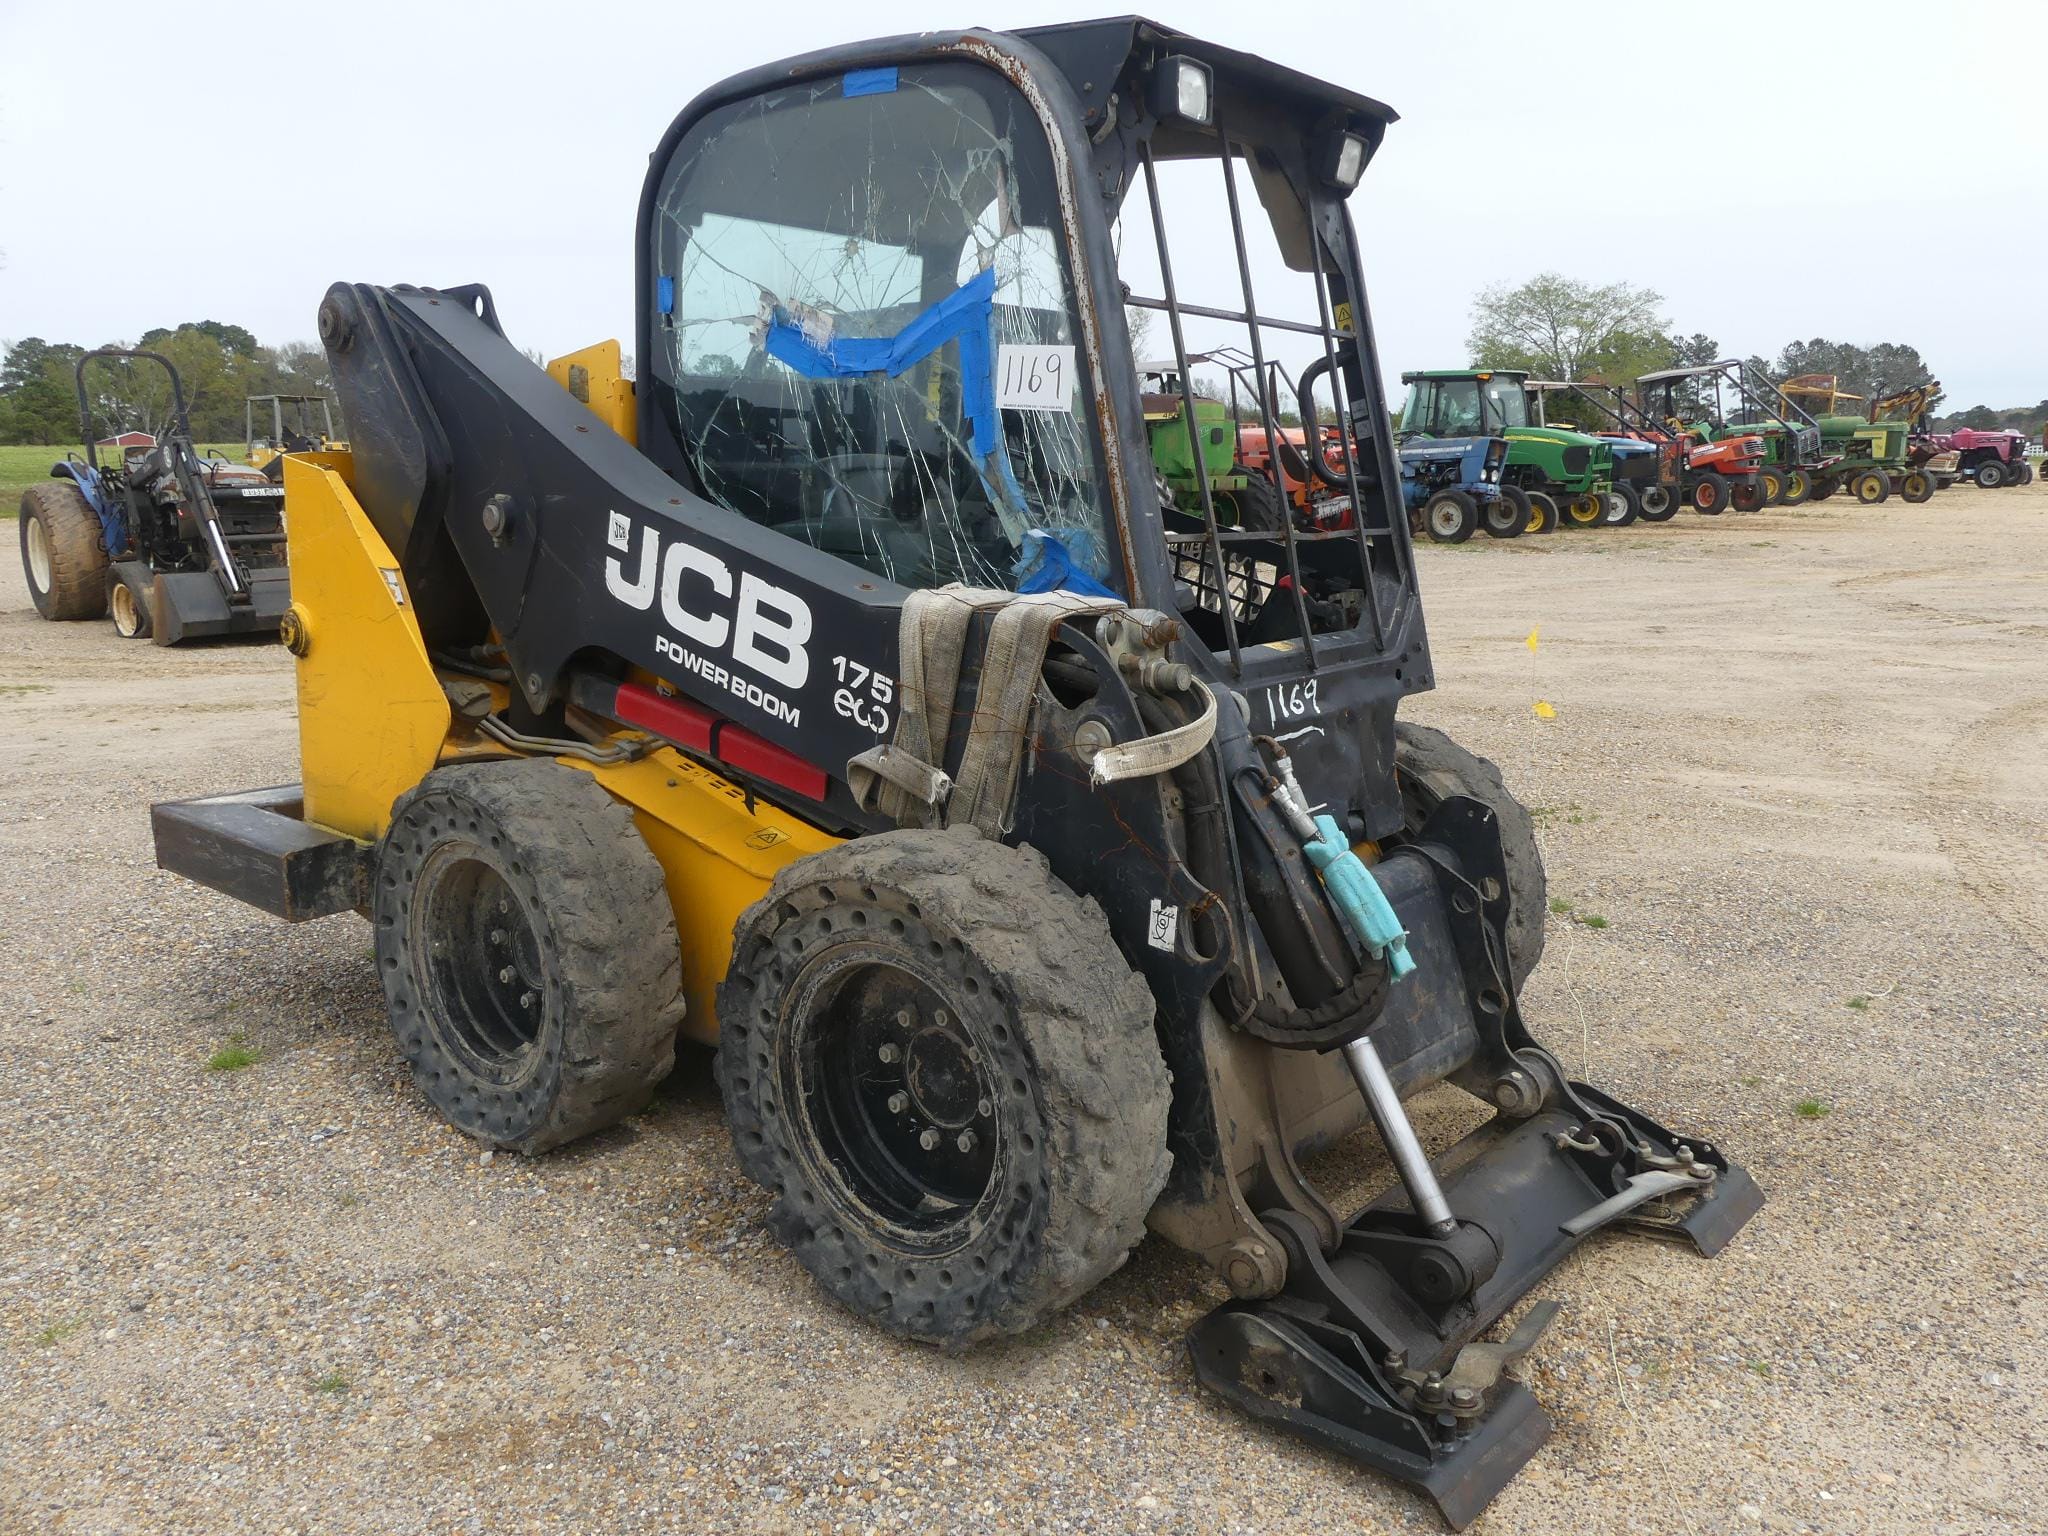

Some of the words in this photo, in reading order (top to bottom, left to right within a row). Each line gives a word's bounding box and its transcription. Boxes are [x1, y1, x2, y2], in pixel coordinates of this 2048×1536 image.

[1004, 353, 1061, 400] 1169
[605, 525, 813, 689] JCB
[655, 634, 730, 690] POWER
[730, 674, 801, 728] BOOM
[832, 655, 894, 704] 175
[1266, 678, 1321, 731] 1169
